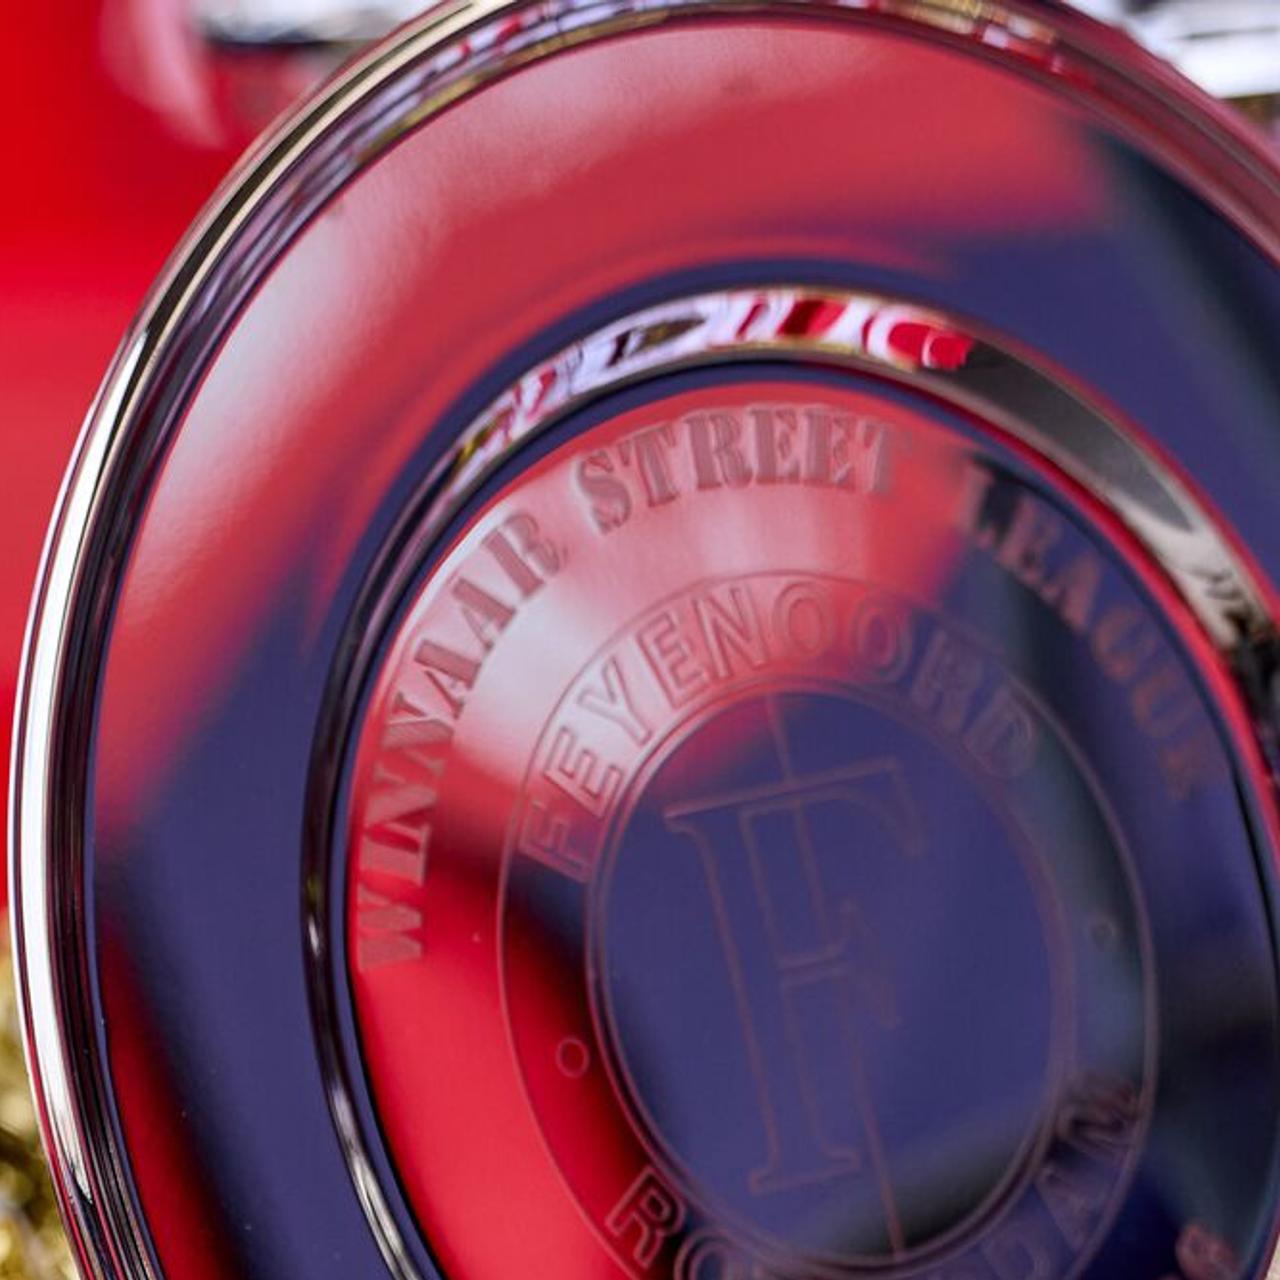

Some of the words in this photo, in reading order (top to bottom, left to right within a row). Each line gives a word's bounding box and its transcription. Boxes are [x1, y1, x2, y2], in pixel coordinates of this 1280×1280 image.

[357, 508, 568, 971] WINNAAR
[574, 404, 910, 535] STREET
[516, 584, 1038, 884] FEYENOORD
